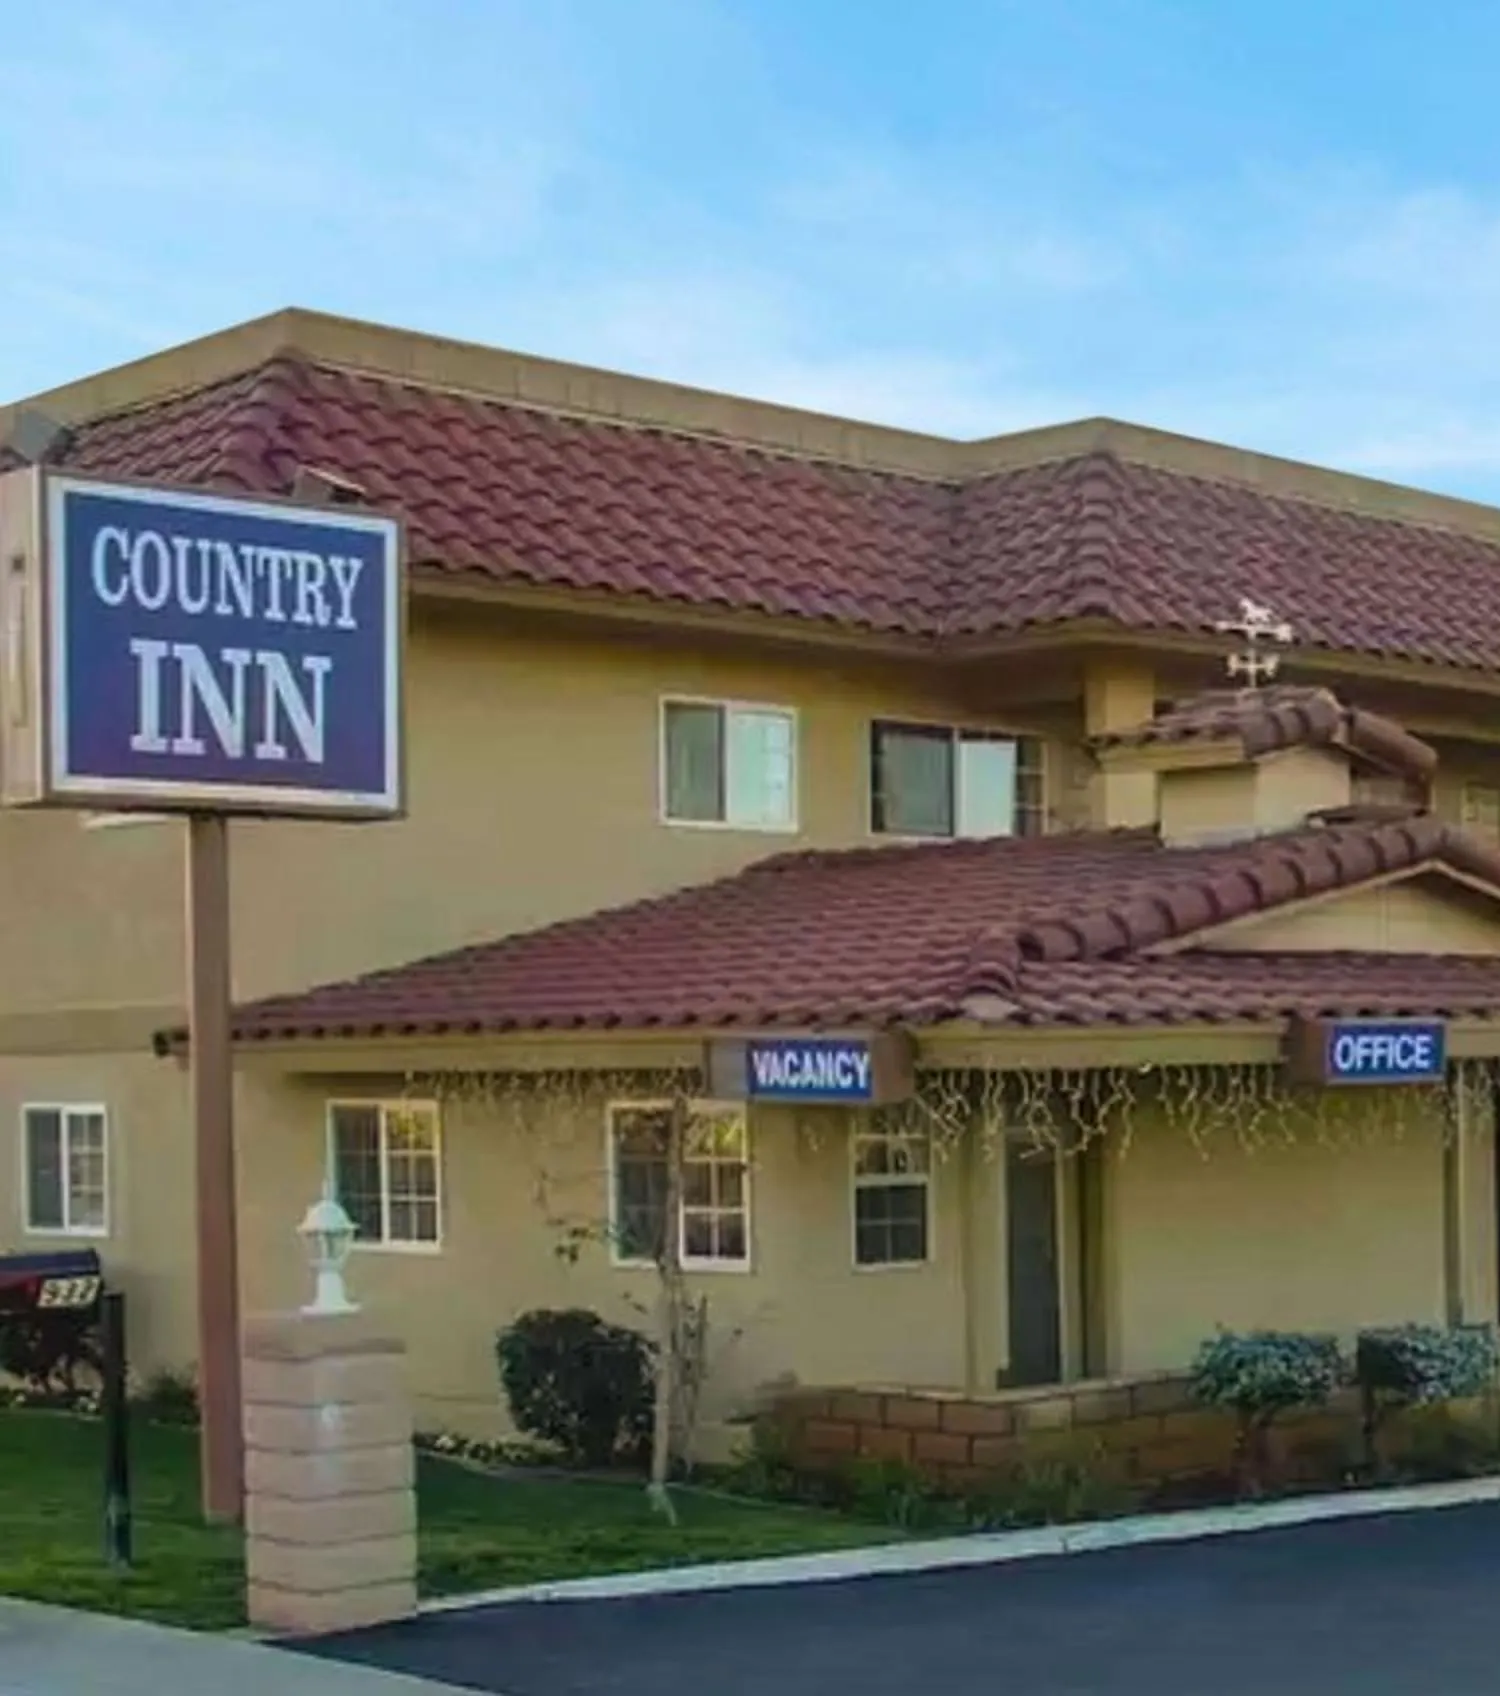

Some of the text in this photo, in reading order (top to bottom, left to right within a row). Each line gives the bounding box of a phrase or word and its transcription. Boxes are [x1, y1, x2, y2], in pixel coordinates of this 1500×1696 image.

[92, 526, 363, 630] COUNTRY
[130, 638, 333, 763] INN
[752, 1051, 870, 1088] VACANCY
[1334, 1034, 1433, 1070] OFFICE
